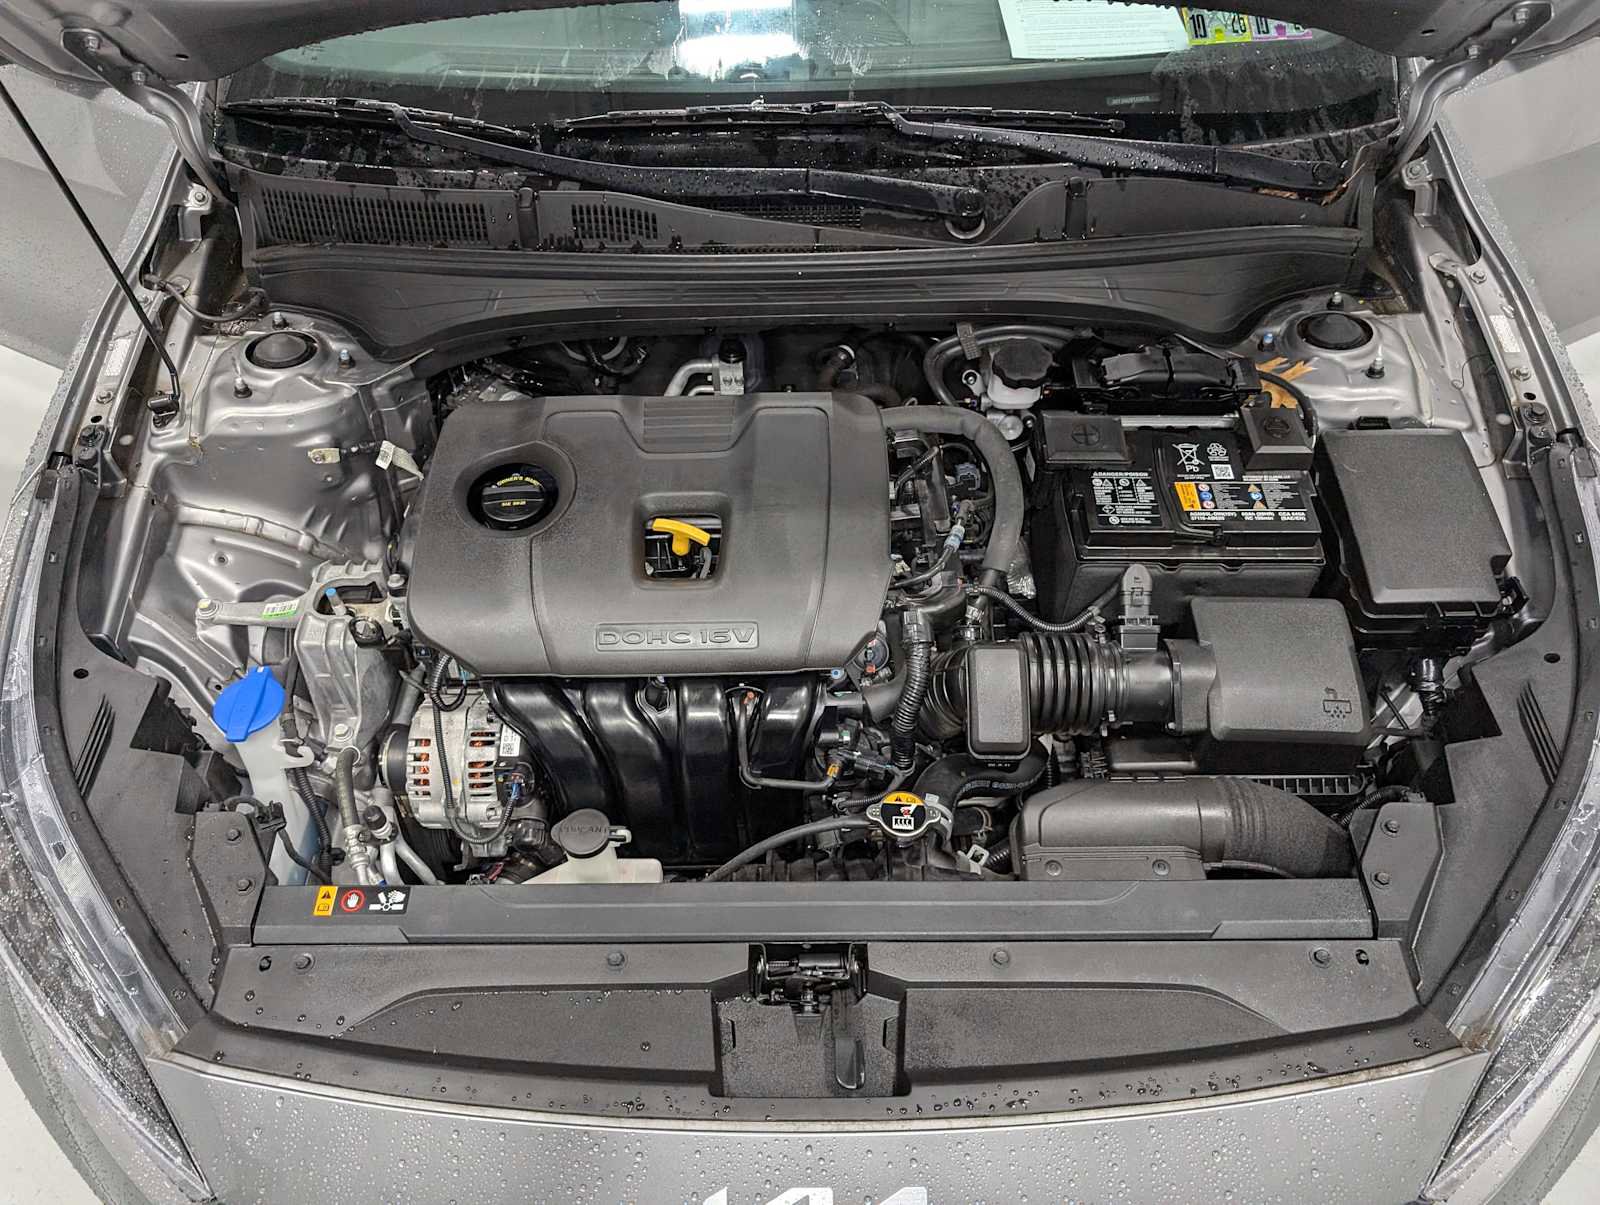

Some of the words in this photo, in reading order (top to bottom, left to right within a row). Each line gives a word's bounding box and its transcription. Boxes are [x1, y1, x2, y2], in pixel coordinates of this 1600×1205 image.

[1189, 14, 1208, 39] 10
[1186, 464, 1200, 473] Pb
[598, 630, 692, 645] DOHC
[700, 628, 755, 644] 16V
